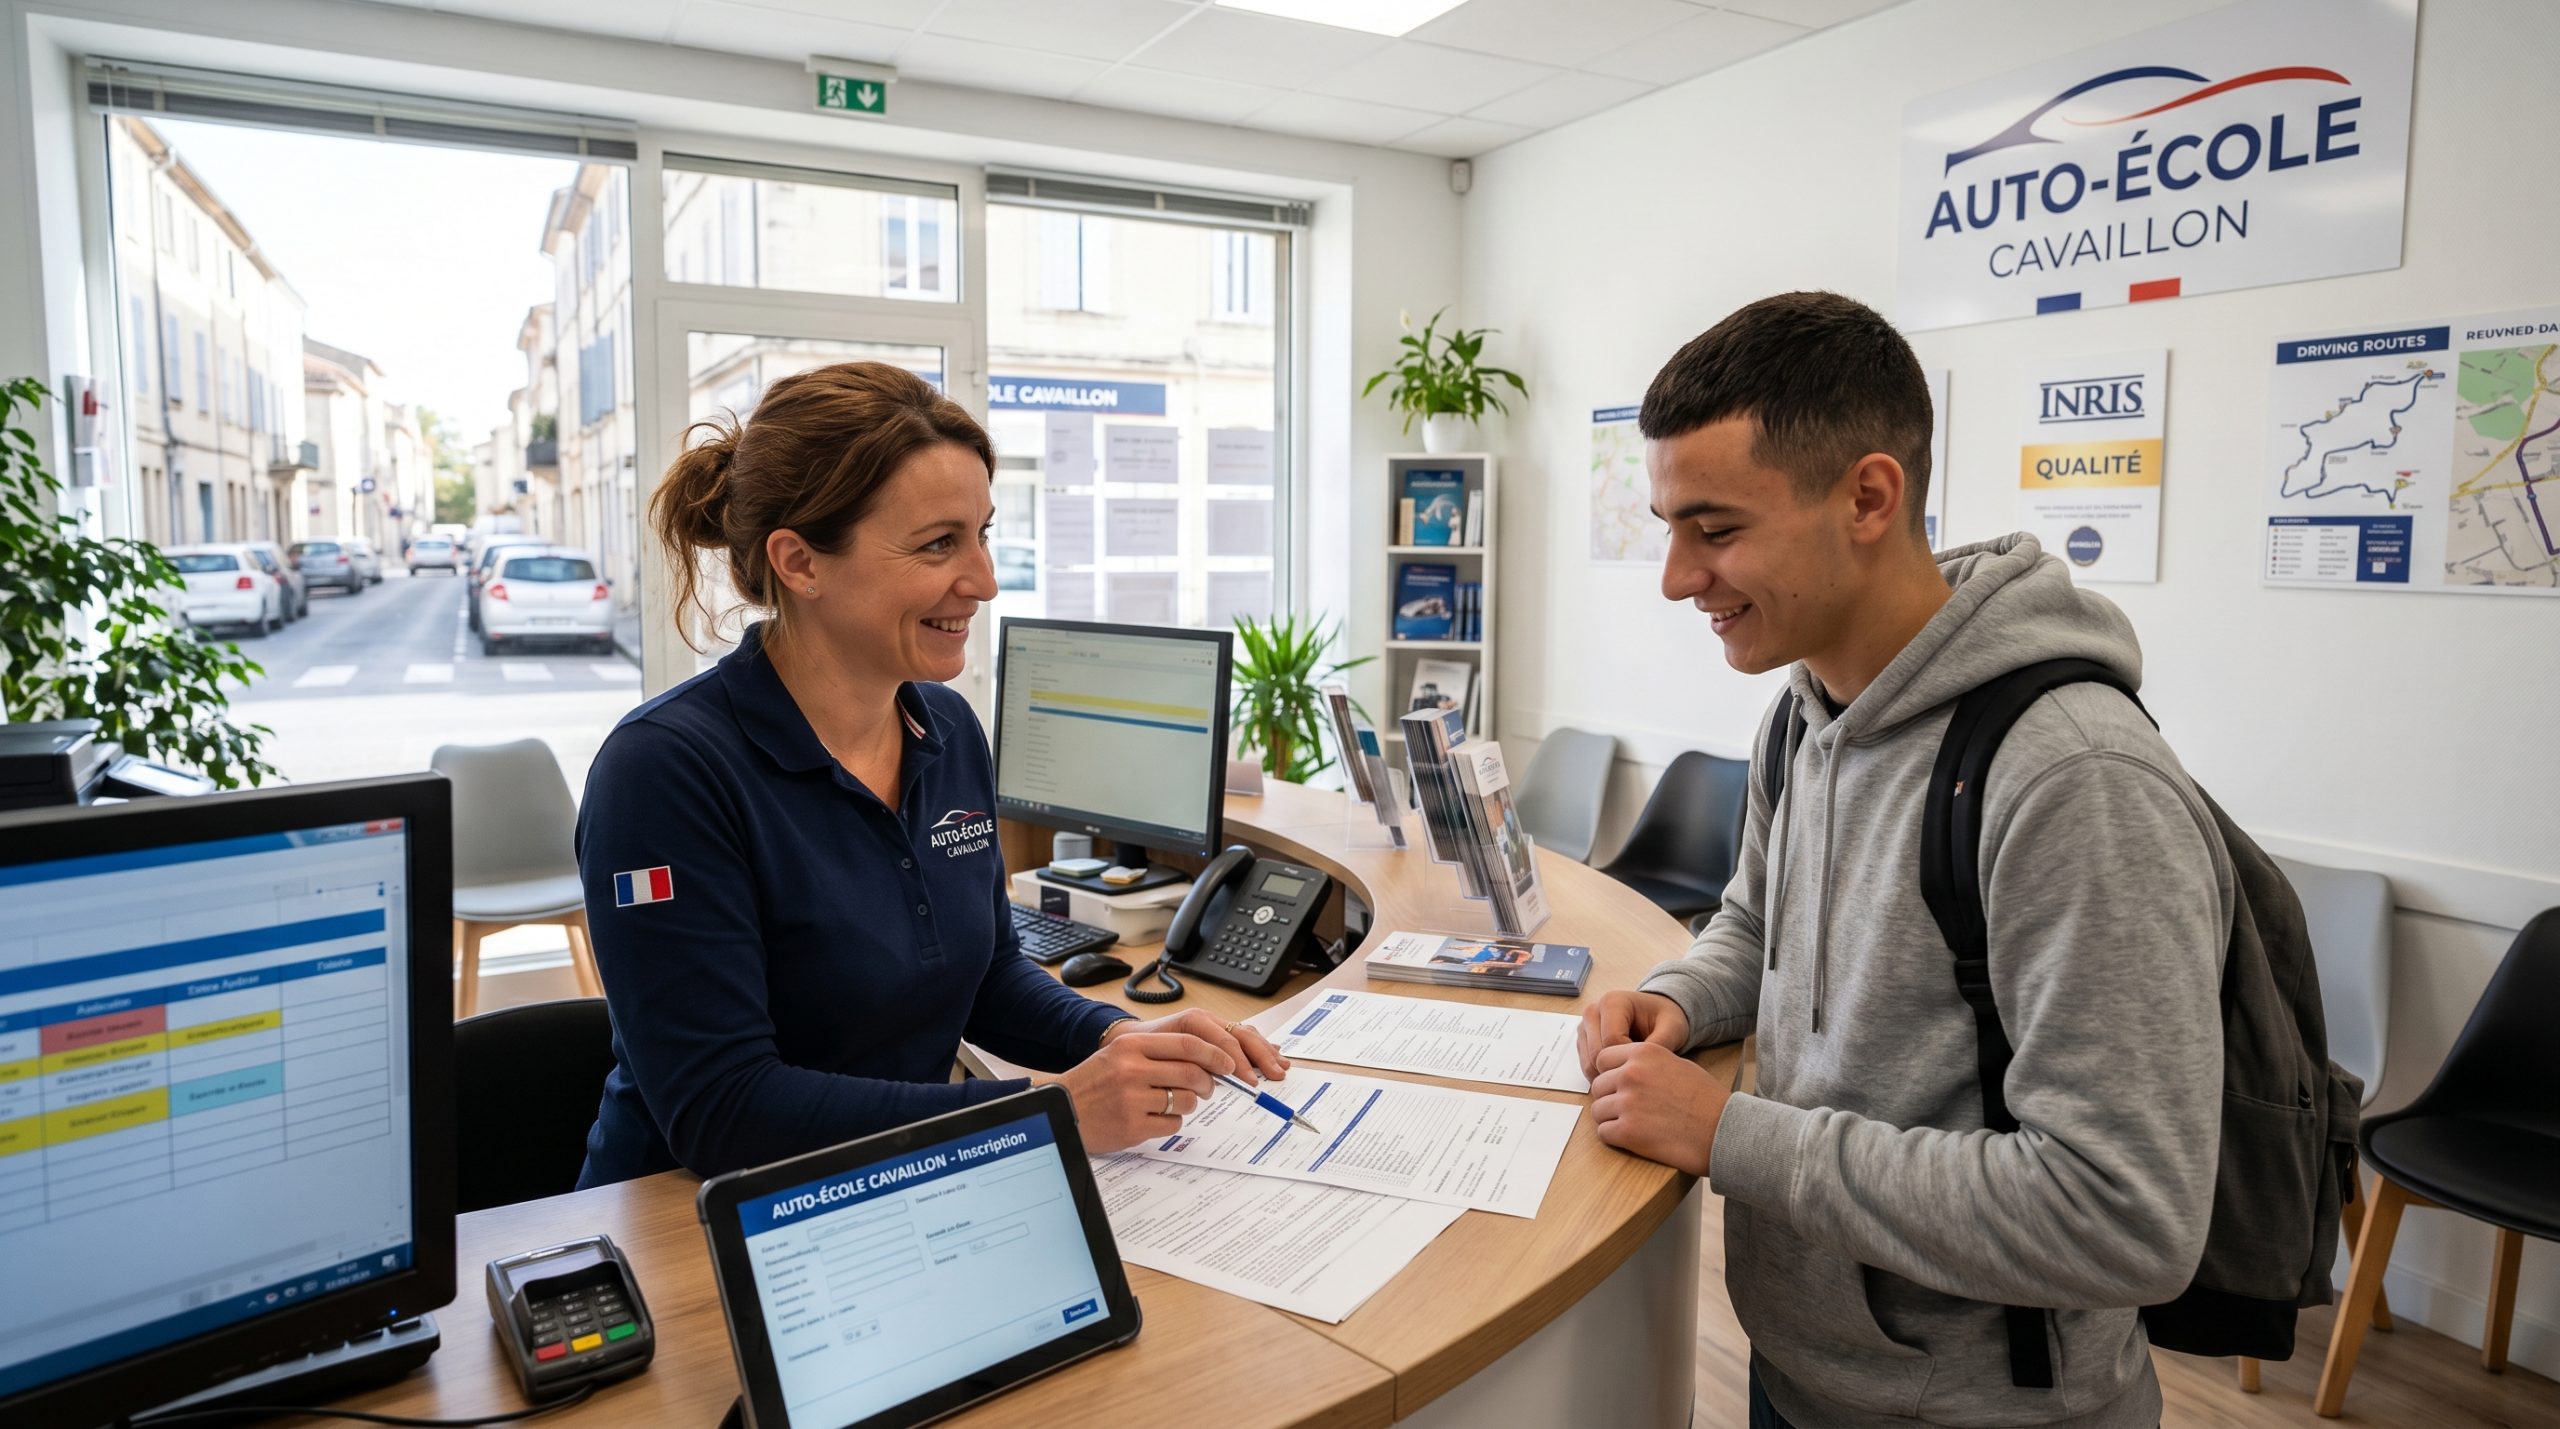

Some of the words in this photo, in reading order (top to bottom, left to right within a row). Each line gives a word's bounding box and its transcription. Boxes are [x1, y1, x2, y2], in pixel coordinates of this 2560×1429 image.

[1925, 96, 2361, 239] AUTO-ÉCOLE
[1989, 201, 2248, 278] CAVAILLON
[2296, 339, 2359, 358] DRIVING
[2363, 335, 2427, 352] ROUTES
[1019, 385, 1118, 407] CAVAILLON
[2036, 450, 2142, 480] QUALITÉ
[930, 819, 994, 848] AUTO-ÉCOLE
[946, 838, 990, 858] CAVAILLON
[772, 1178, 867, 1219] AUTO-ÉCOLE
[869, 1153, 947, 1188] CAVAILLON
[957, 1131, 1028, 1162] Inscription
